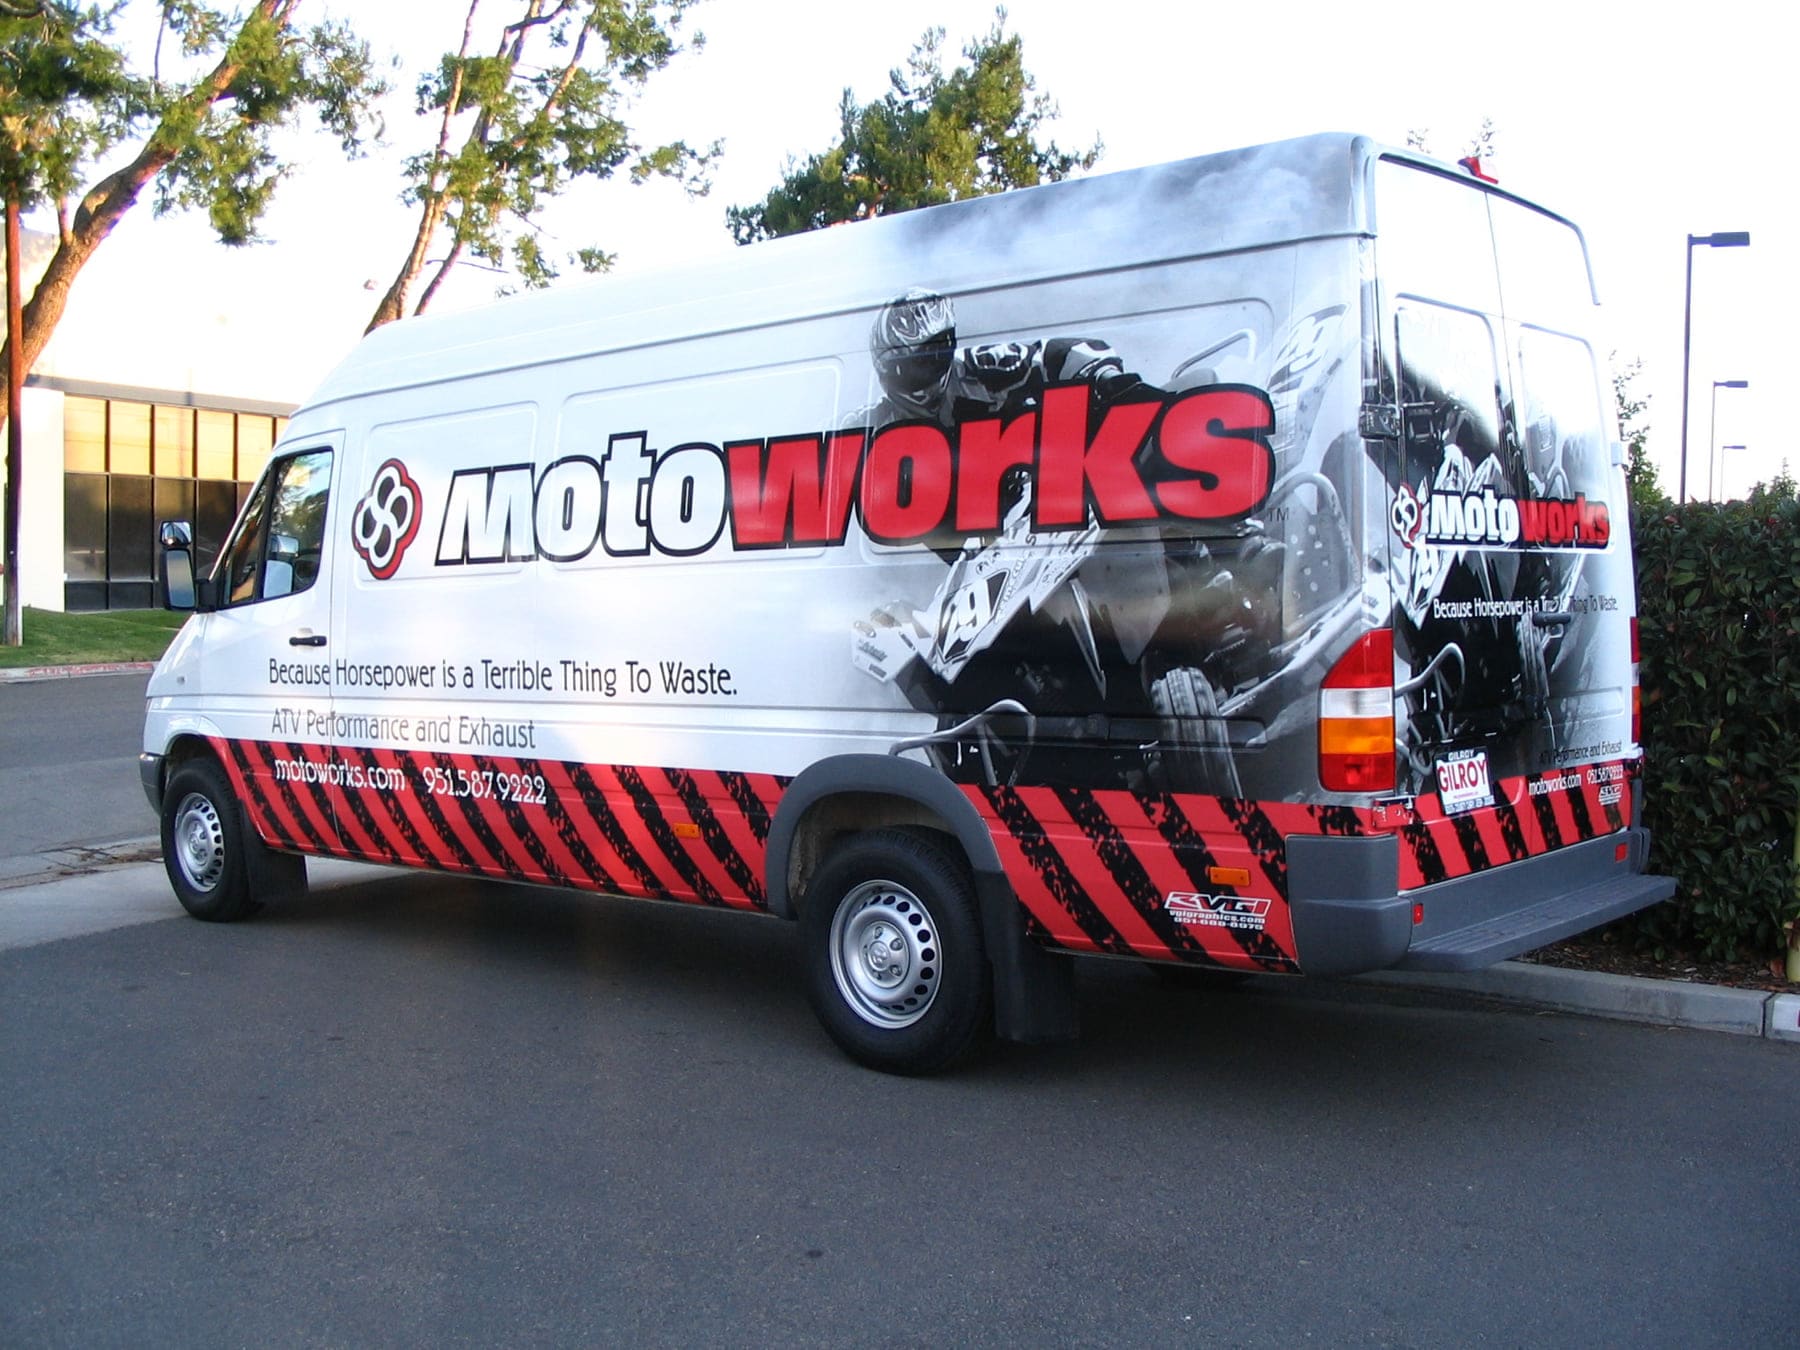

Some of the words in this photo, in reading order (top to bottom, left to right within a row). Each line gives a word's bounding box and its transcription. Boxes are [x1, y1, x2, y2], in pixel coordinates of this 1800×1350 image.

[1433, 598, 1472, 618] Because
[1474, 598, 1524, 617] Horsepower
[269, 659, 330, 686] Because
[336, 659, 436, 691] Horsepower
[442, 660, 457, 689] is
[463, 667, 474, 690] a
[481, 659, 552, 692] Terrible
[560, 660, 617, 697] Thing
[625, 661, 651, 694] To
[660, 661, 737, 696] Waste.
[271, 708, 301, 735] ATV
[306, 710, 409, 743] Performance
[415, 713, 451, 744] and
[459, 716, 536, 750] Exhaust
[275, 757, 405, 792] motoworks.com
[423, 770, 547, 805] 951.587.9222
[1438, 760, 1487, 792] GILROY
[1529, 772, 1582, 796] motoworks.com
